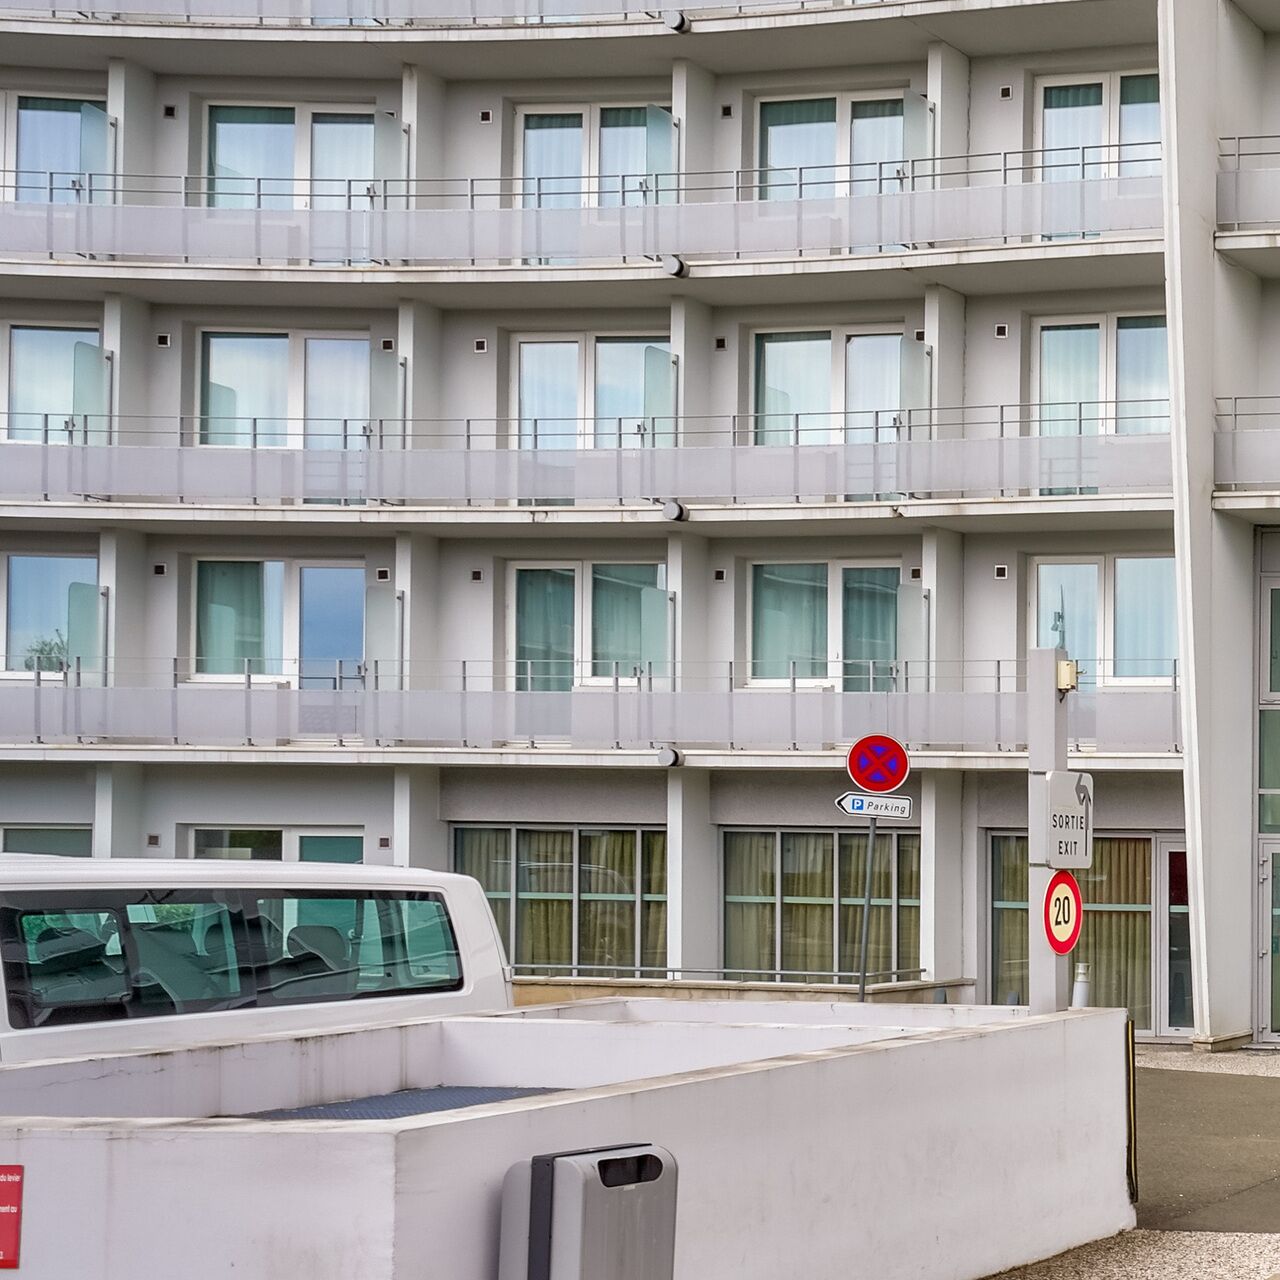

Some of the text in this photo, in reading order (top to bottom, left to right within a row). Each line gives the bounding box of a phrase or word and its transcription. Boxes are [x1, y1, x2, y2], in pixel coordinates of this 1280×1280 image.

[867, 801, 906, 815] Parking
[1052, 814, 1084, 830] SORTIE
[1058, 841, 1078, 855] EXIT
[1054, 895, 1071, 926] 20
